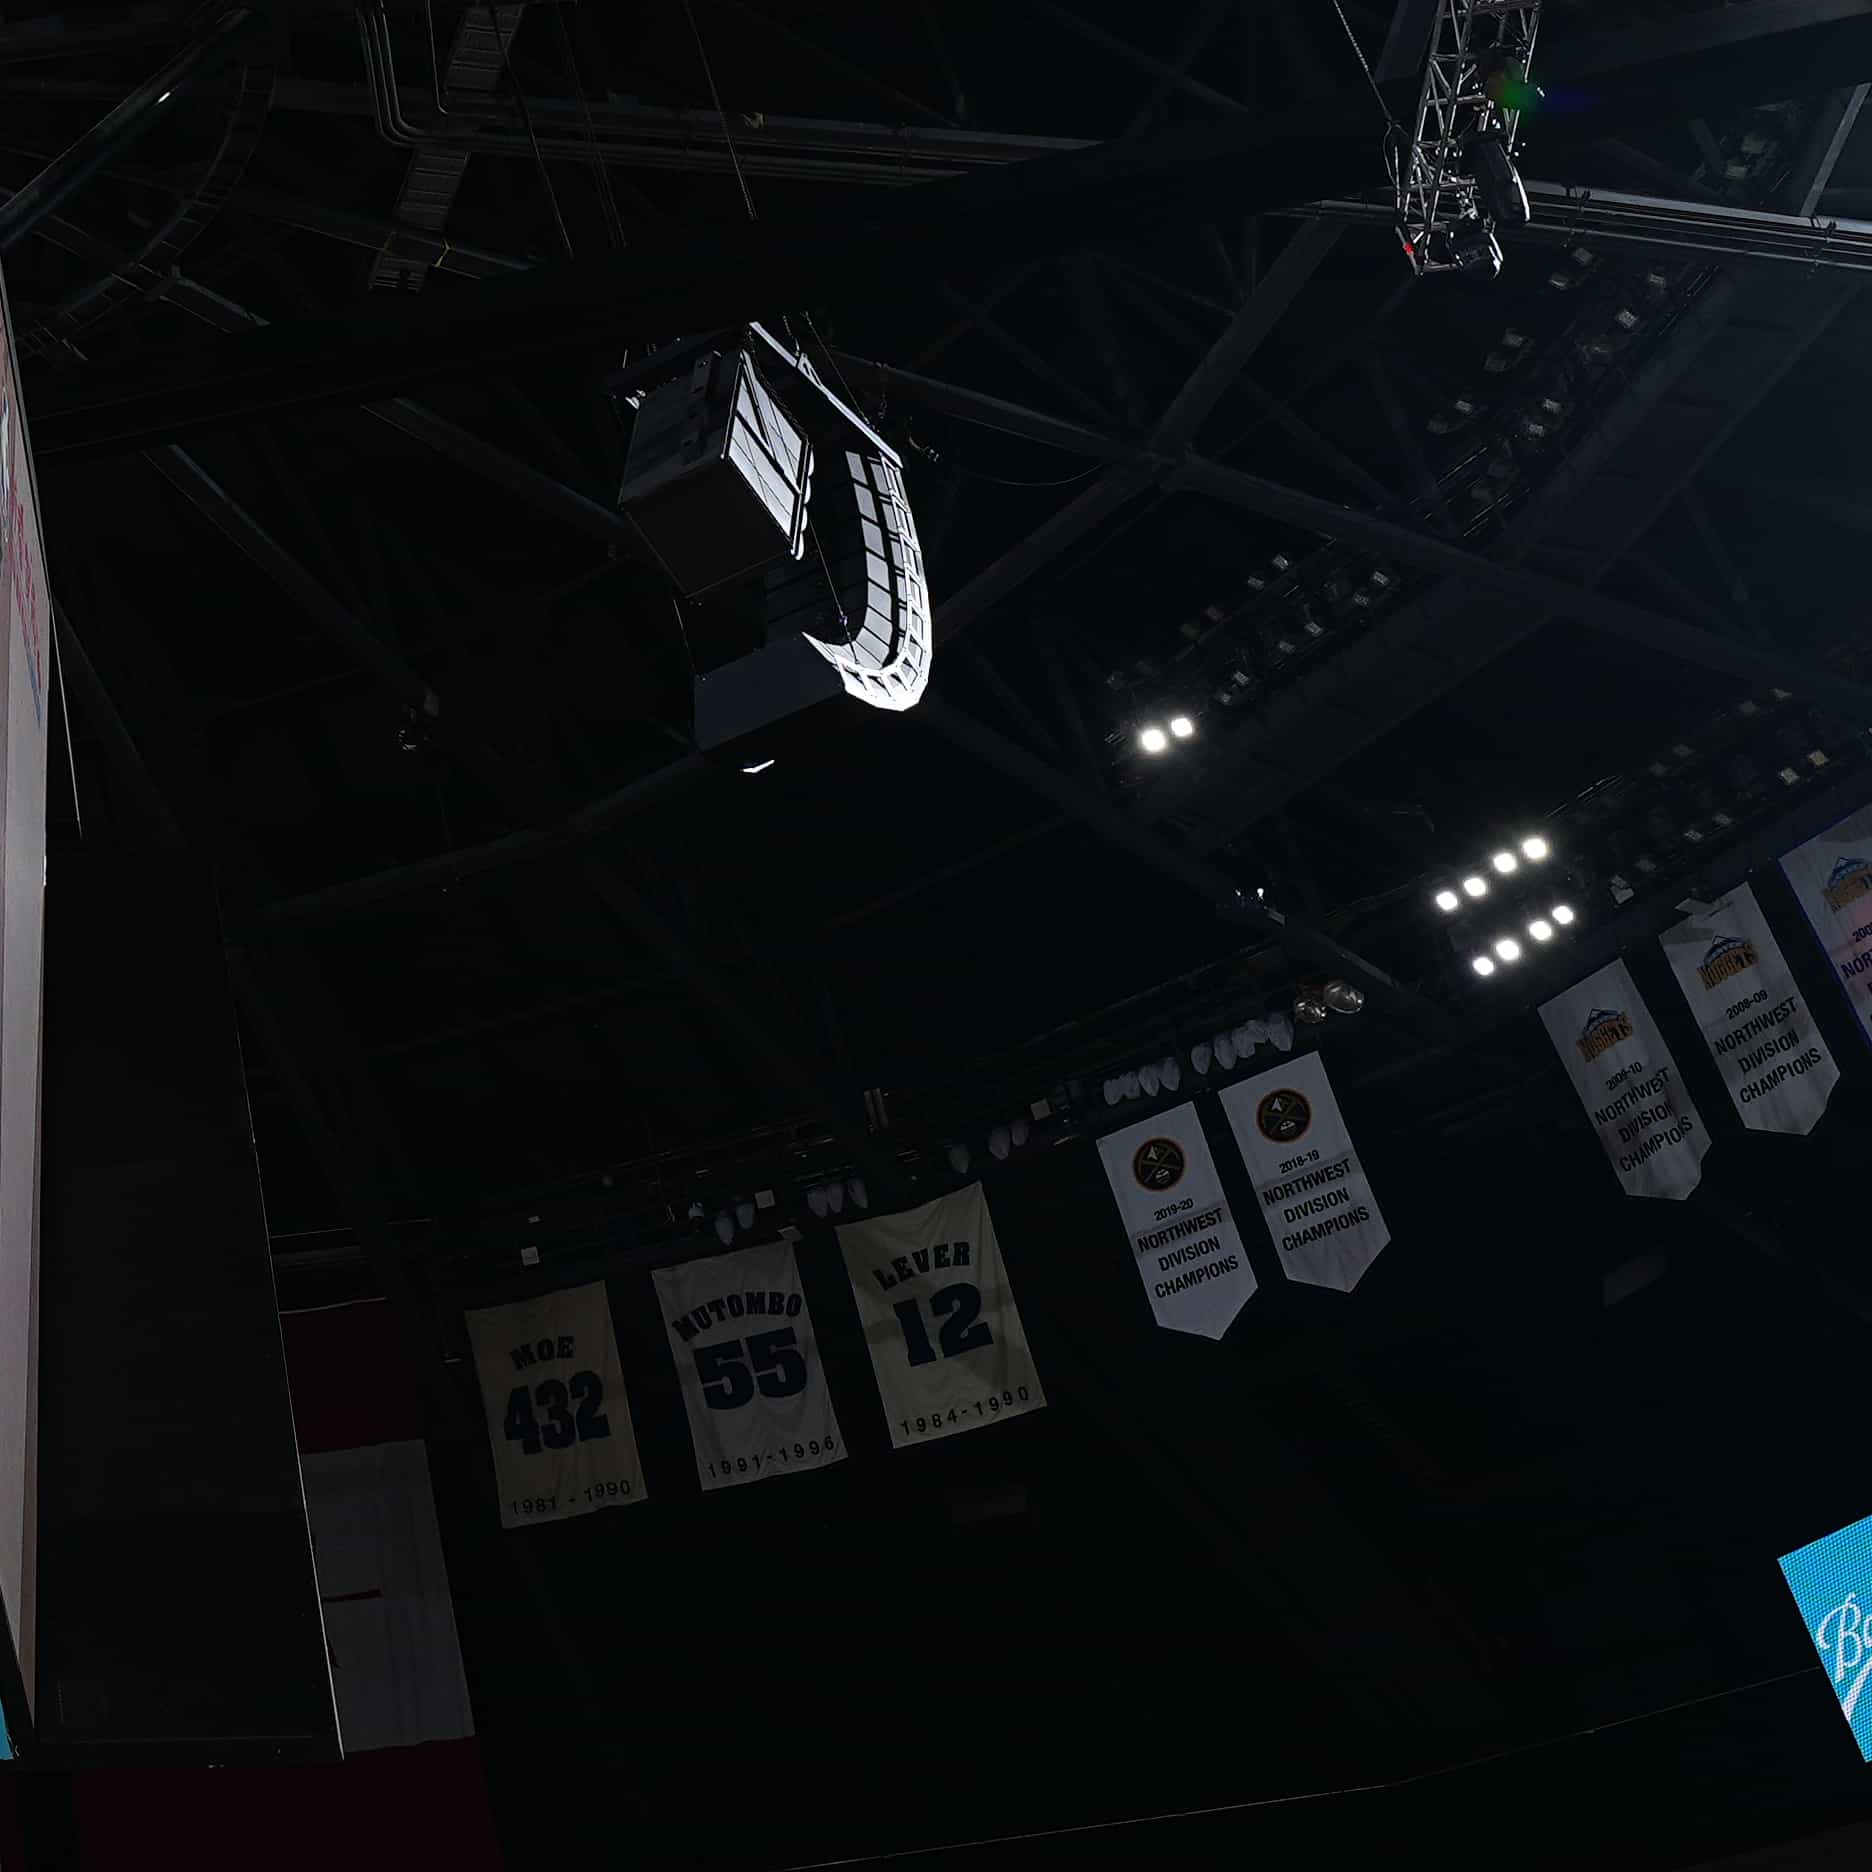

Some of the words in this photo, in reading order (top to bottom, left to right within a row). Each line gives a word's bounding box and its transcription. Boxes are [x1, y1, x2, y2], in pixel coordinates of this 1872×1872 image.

[1713, 996, 1798, 1056] NORTHWEST
[1737, 1029, 1801, 1074] DIVISION
[1739, 1047, 1822, 1104] CHAMPIONS
[1594, 1066, 1670, 1126] NORTHWEST
[1262, 1157, 1352, 1206] NORTHWEST
[1278, 1149, 1320, 1174] 2018-19
[1153, 1197, 1194, 1221] 2019-20
[1281, 1205, 1371, 1252] CHAMPIONS
[1283, 1187, 1350, 1224] DIVISION
[1136, 1207, 1224, 1254] NORTHWEST
[1157, 1235, 1221, 1272] DIVISION
[871, 1240, 972, 1293] LEVER
[1154, 1254, 1240, 1299] CHAMPIONS
[671, 1289, 804, 1342] MUTOMBO
[893, 1281, 994, 1367] 12
[508, 1334, 575, 1372] MOE
[694, 1327, 809, 1411] 55
[503, 1369, 612, 1456] 432
